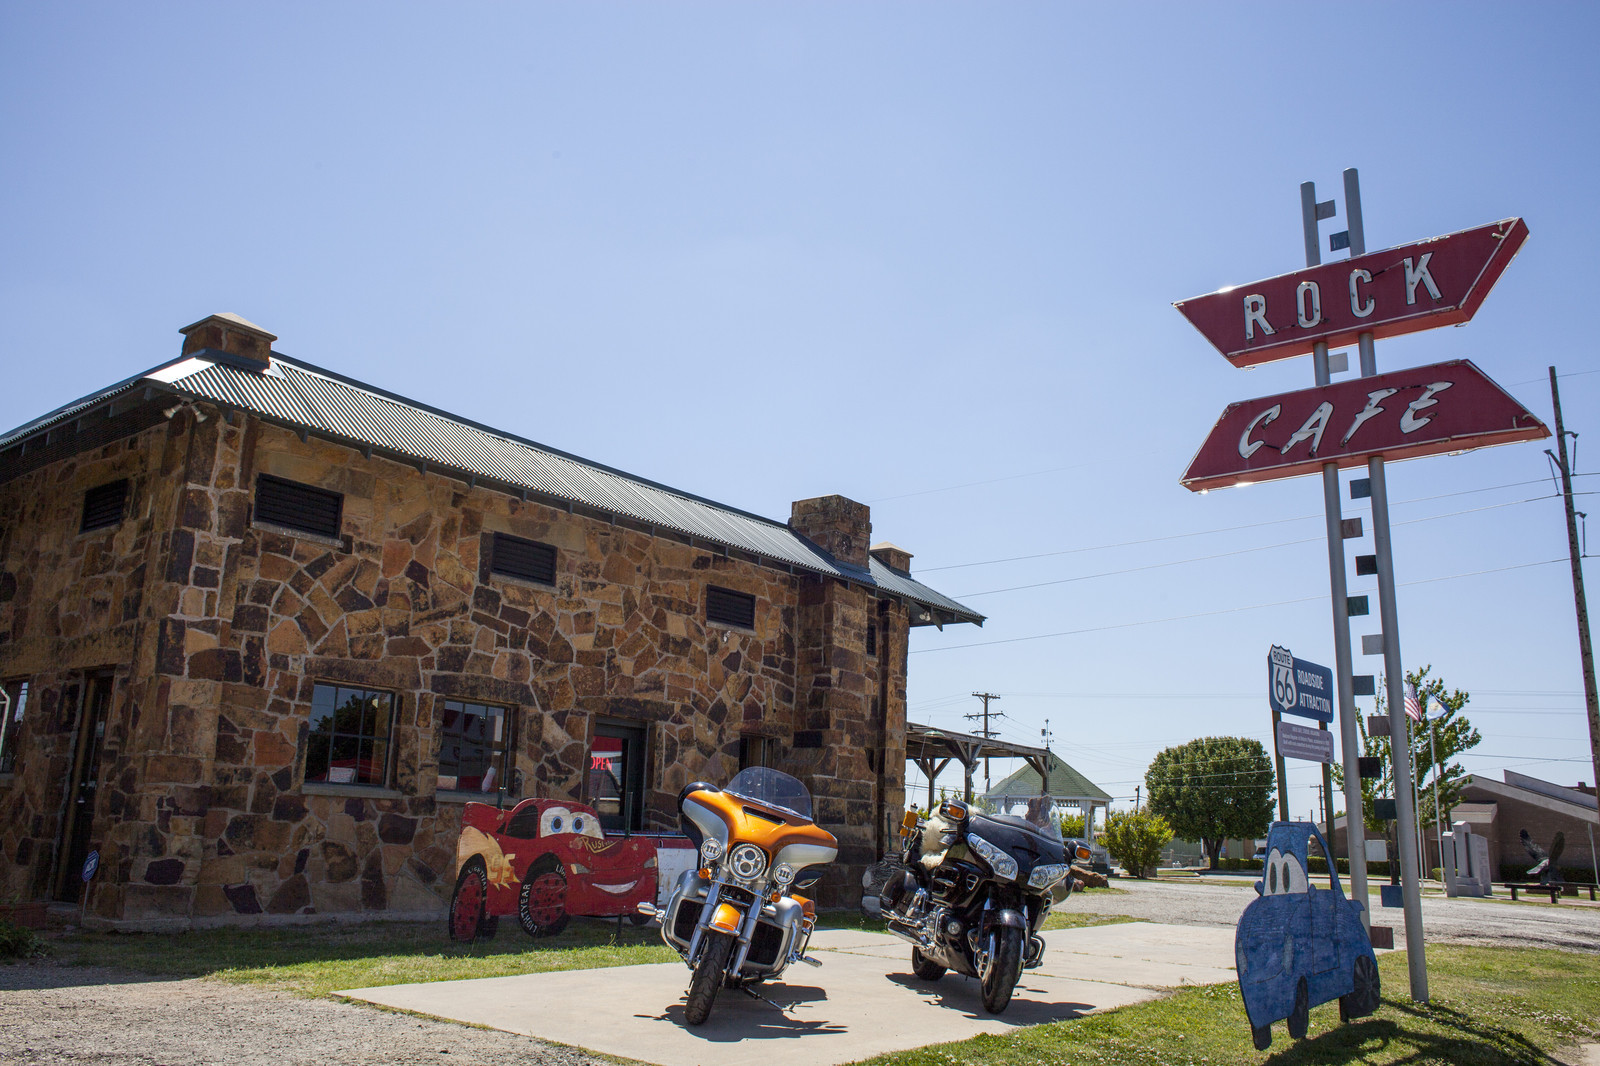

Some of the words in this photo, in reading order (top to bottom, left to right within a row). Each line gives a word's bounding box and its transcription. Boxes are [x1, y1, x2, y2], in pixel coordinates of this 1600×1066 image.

[1243, 252, 1442, 340] ROCK
[1238, 381, 1455, 459] CAFE
[1273, 650, 1291, 665] ROUTE
[1275, 667, 1294, 705] 66
[1297, 669, 1324, 690] ROADSIDE
[1300, 692, 1331, 713] ATTRACTION
[490, 853, 517, 884] 95
[520, 883, 538, 933] LIGHTYEAR
